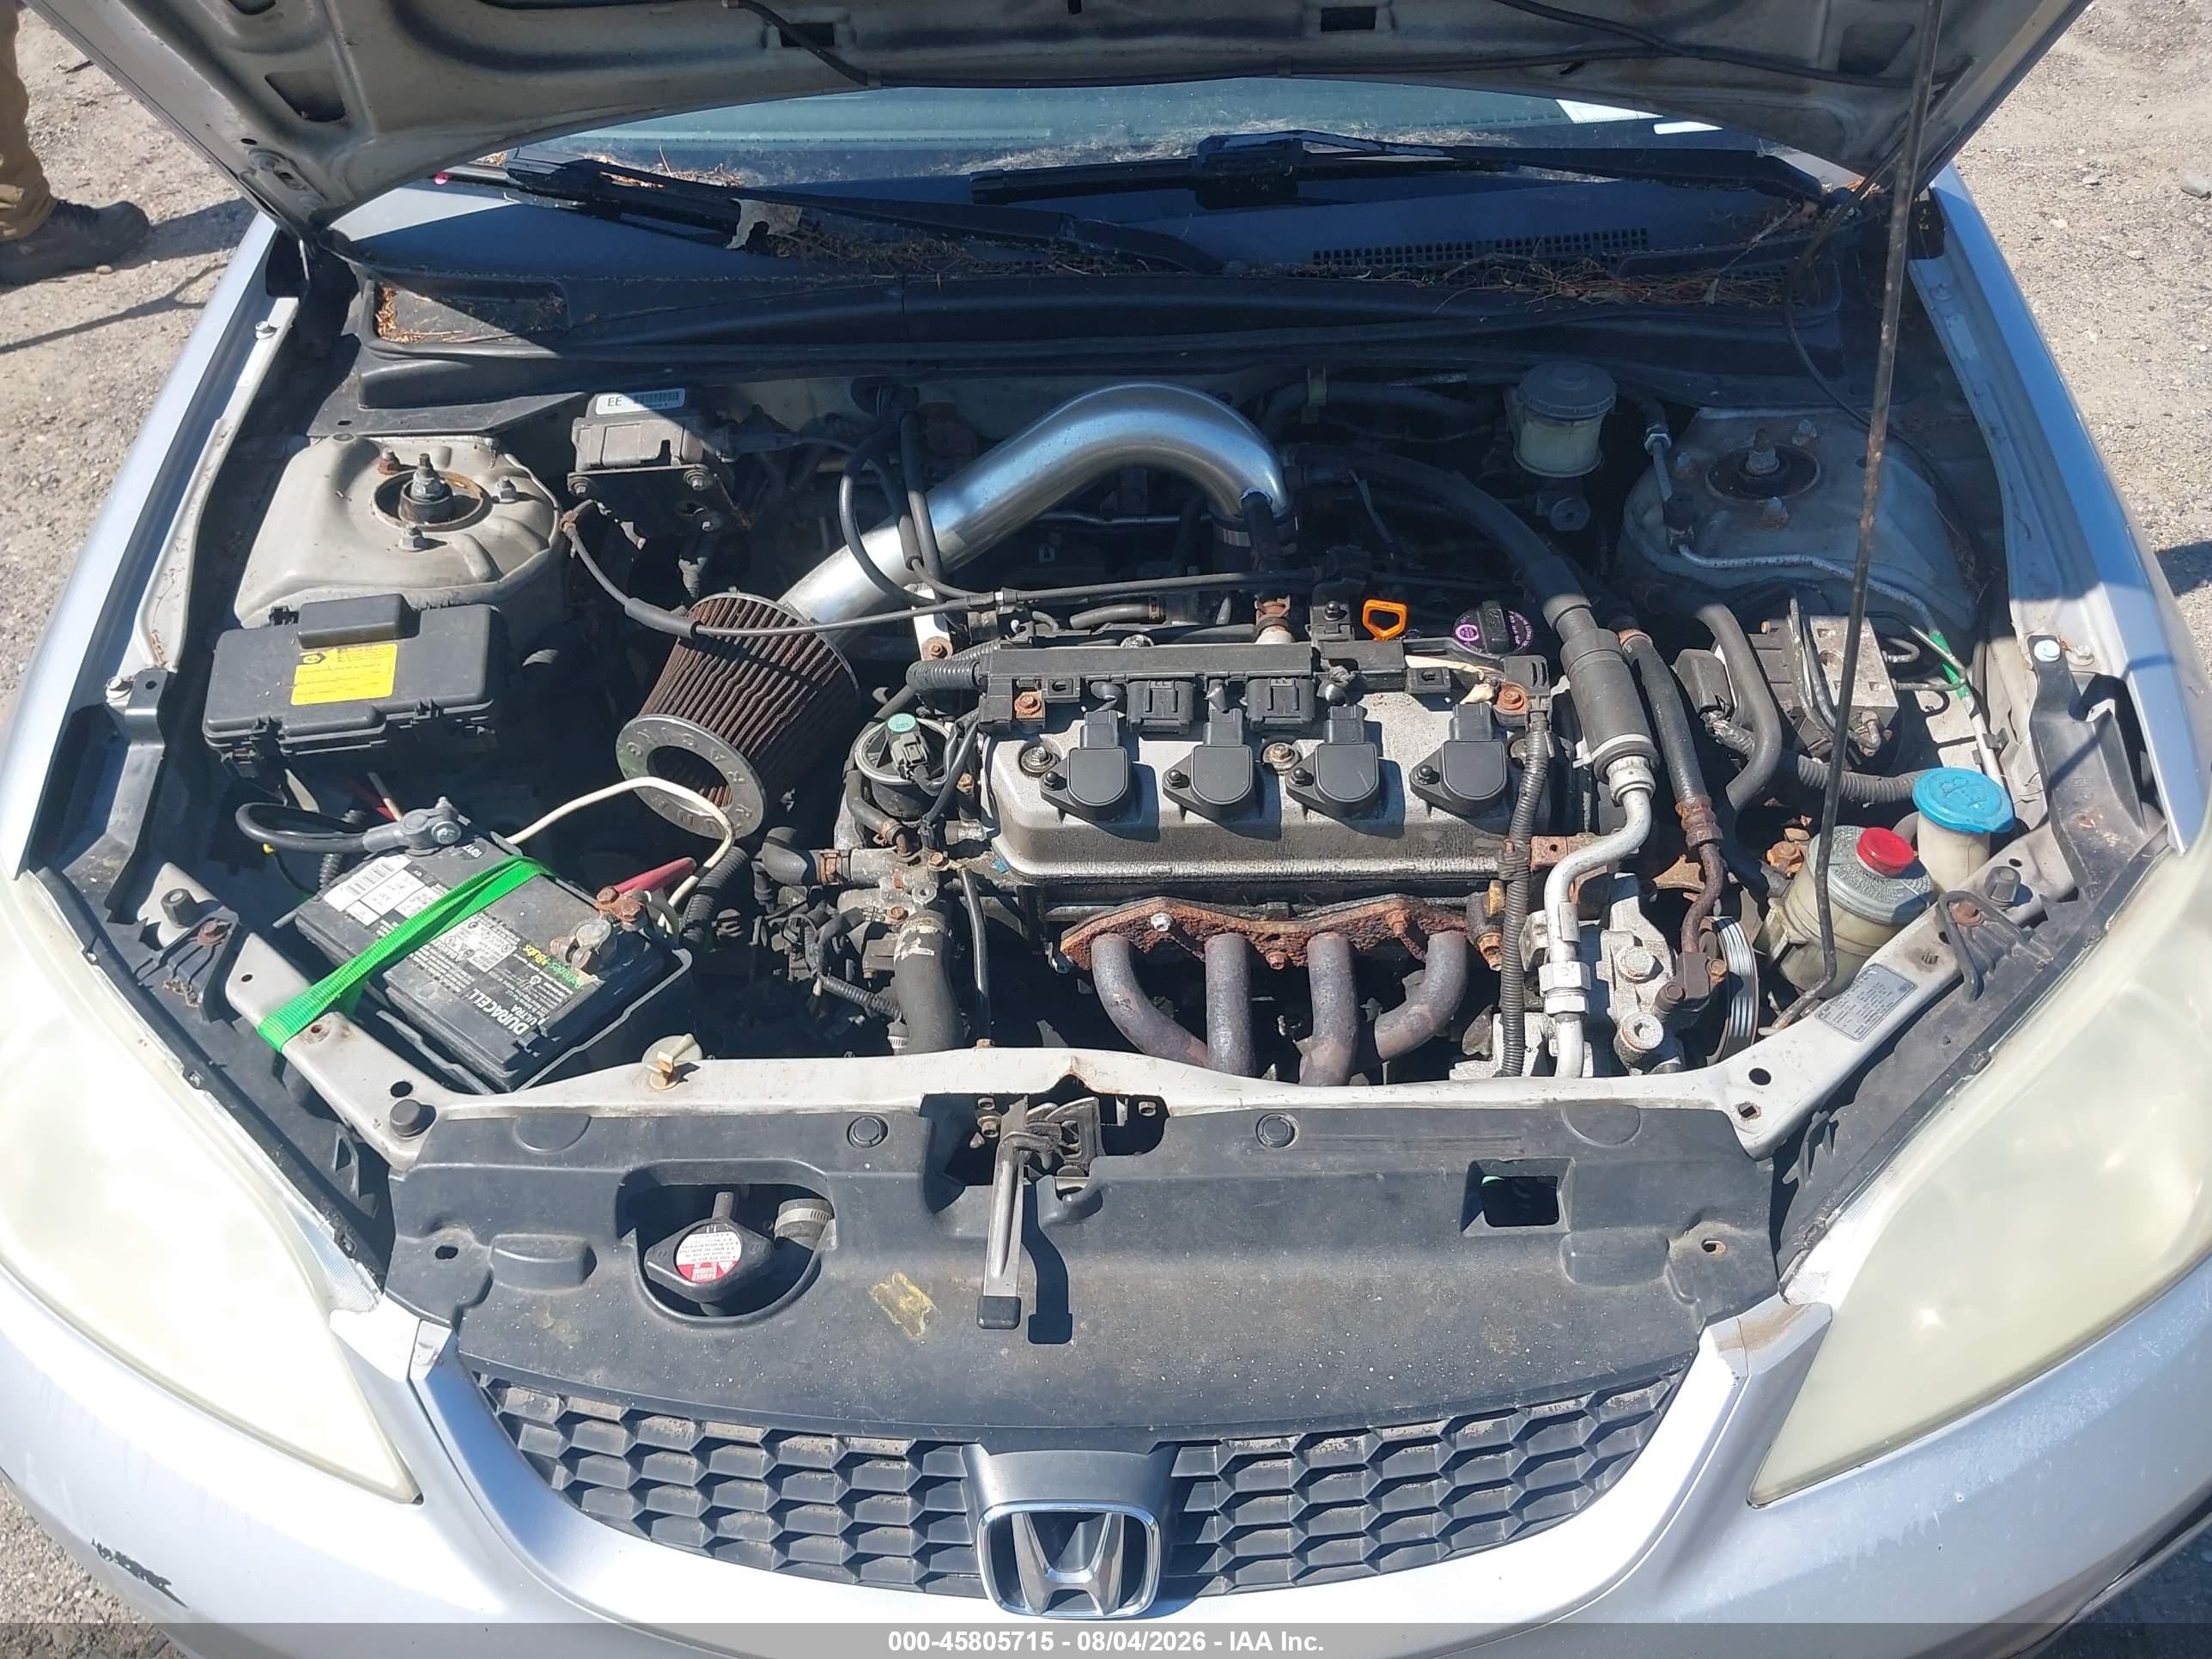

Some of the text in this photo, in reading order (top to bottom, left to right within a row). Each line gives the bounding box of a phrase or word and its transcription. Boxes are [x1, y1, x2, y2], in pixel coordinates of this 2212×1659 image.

[607, 397, 623, 407] EE
[471, 988, 530, 1036] DURACELL
[510, 1003, 538, 1026] ULTRA
